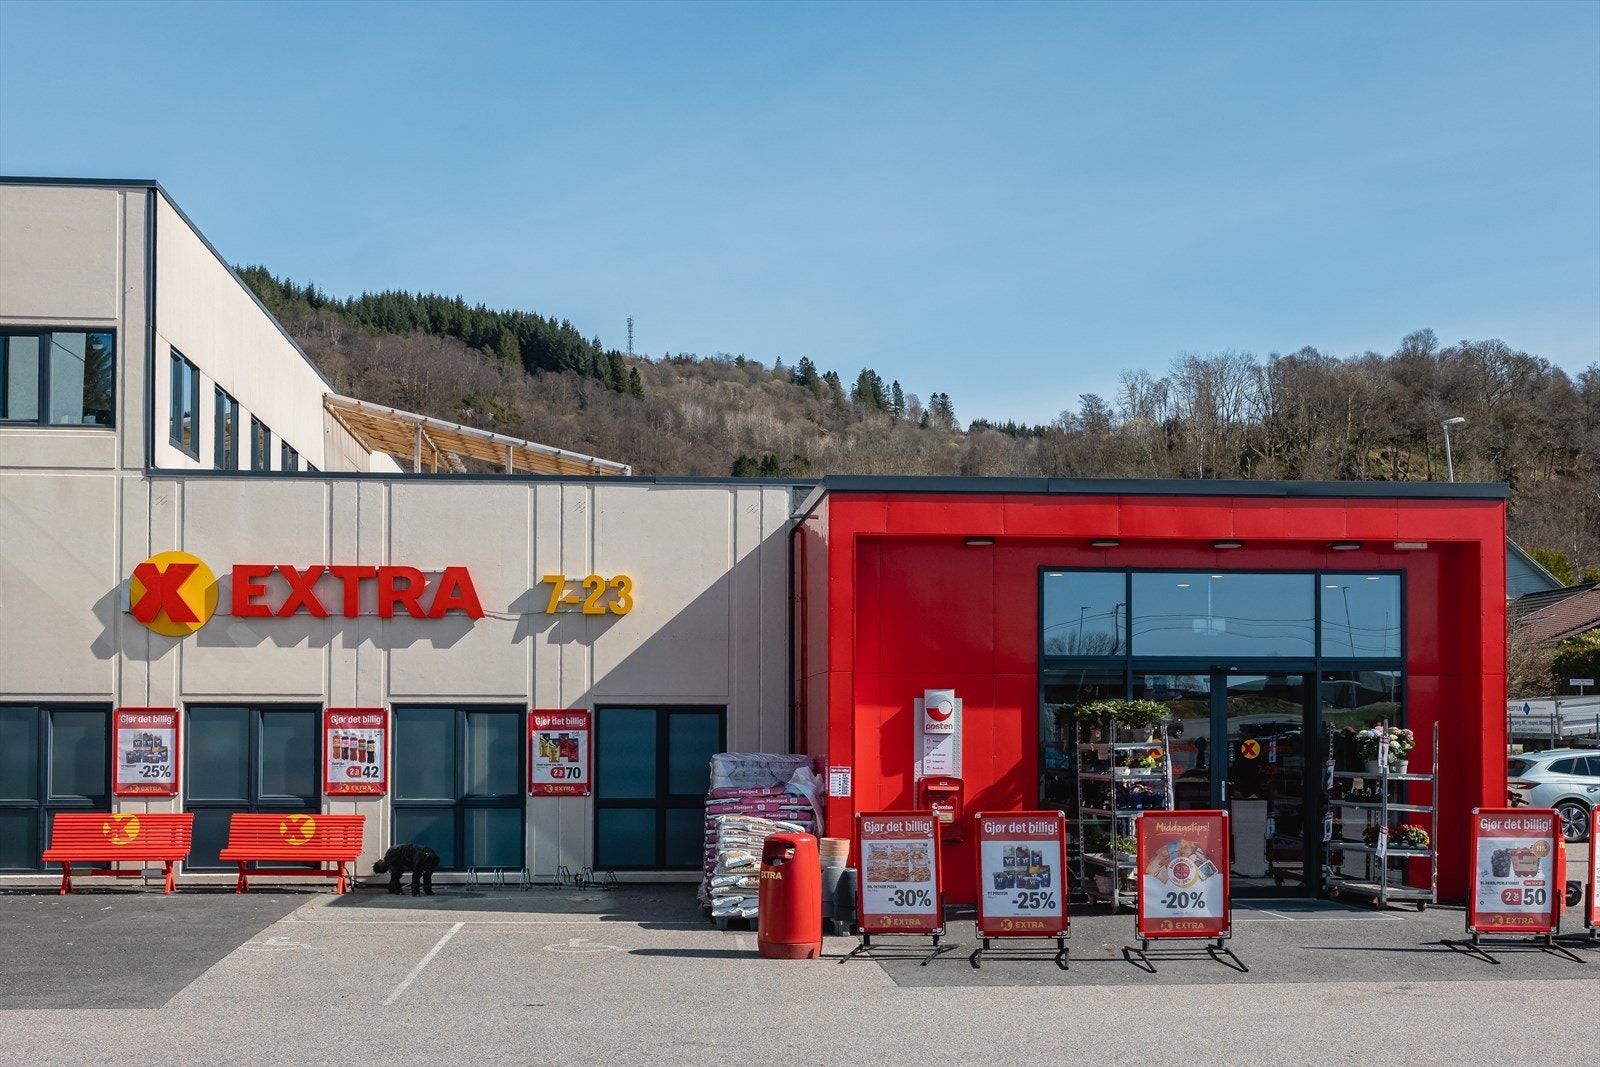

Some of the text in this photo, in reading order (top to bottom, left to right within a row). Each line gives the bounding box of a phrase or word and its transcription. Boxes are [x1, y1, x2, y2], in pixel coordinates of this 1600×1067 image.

[232, 564, 485, 618] EXTRA
[543, 574, 634, 614] 7-23
[120, 714, 174, 724] Gjør det billig!
[330, 715, 384, 724] Gjør det billig!
[535, 717, 550, 726] Gjør
[566, 718, 586, 726] billig!
[926, 722, 953, 731] posten
[139, 765, 171, 778] -25%
[362, 766, 379, 778] 42
[566, 767, 581, 778] 70
[864, 821, 932, 834] Gjør det billig!
[985, 822, 1058, 835] Gjør det billig!
[1156, 822, 1210, 834] Middagstips!
[1480, 818, 1552, 831] Gjør det billig!
[761, 871, 782, 879] EXTRA
[888, 889, 932, 906] -30%
[1012, 892, 1056, 909] -25%
[1161, 892, 1205, 908] -20%
[1506, 892, 1512, 901] 2
[1524, 888, 1547, 905] 50
